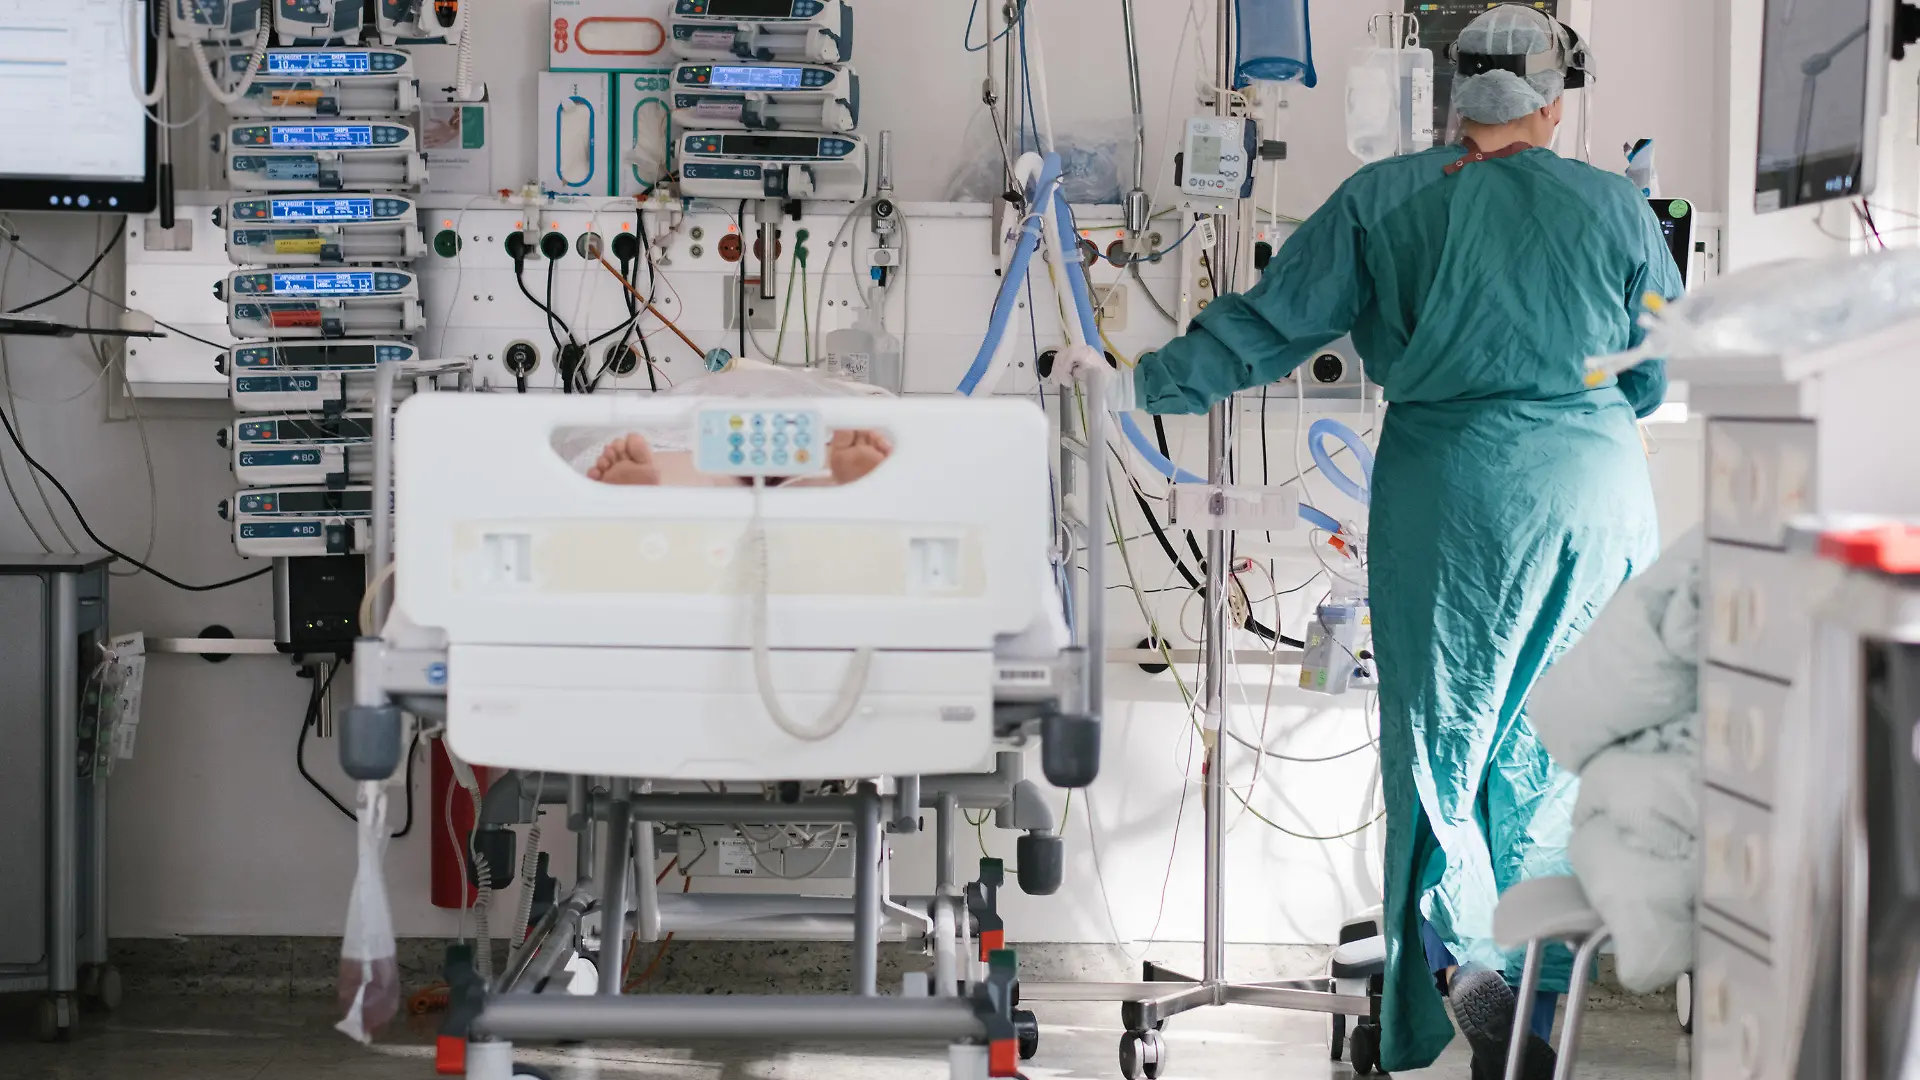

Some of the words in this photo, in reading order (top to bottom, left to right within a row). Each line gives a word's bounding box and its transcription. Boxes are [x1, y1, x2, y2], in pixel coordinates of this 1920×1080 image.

[236, 161, 248, 169] CC
[686, 169, 697, 177] CC
[743, 169, 755, 177] BD
[237, 309, 249, 317] CC
[239, 382, 250, 391] CC
[298, 380, 311, 388] BD
[242, 456, 254, 465] CC
[301, 453, 315, 462] BD
[302, 526, 315, 534] BD
